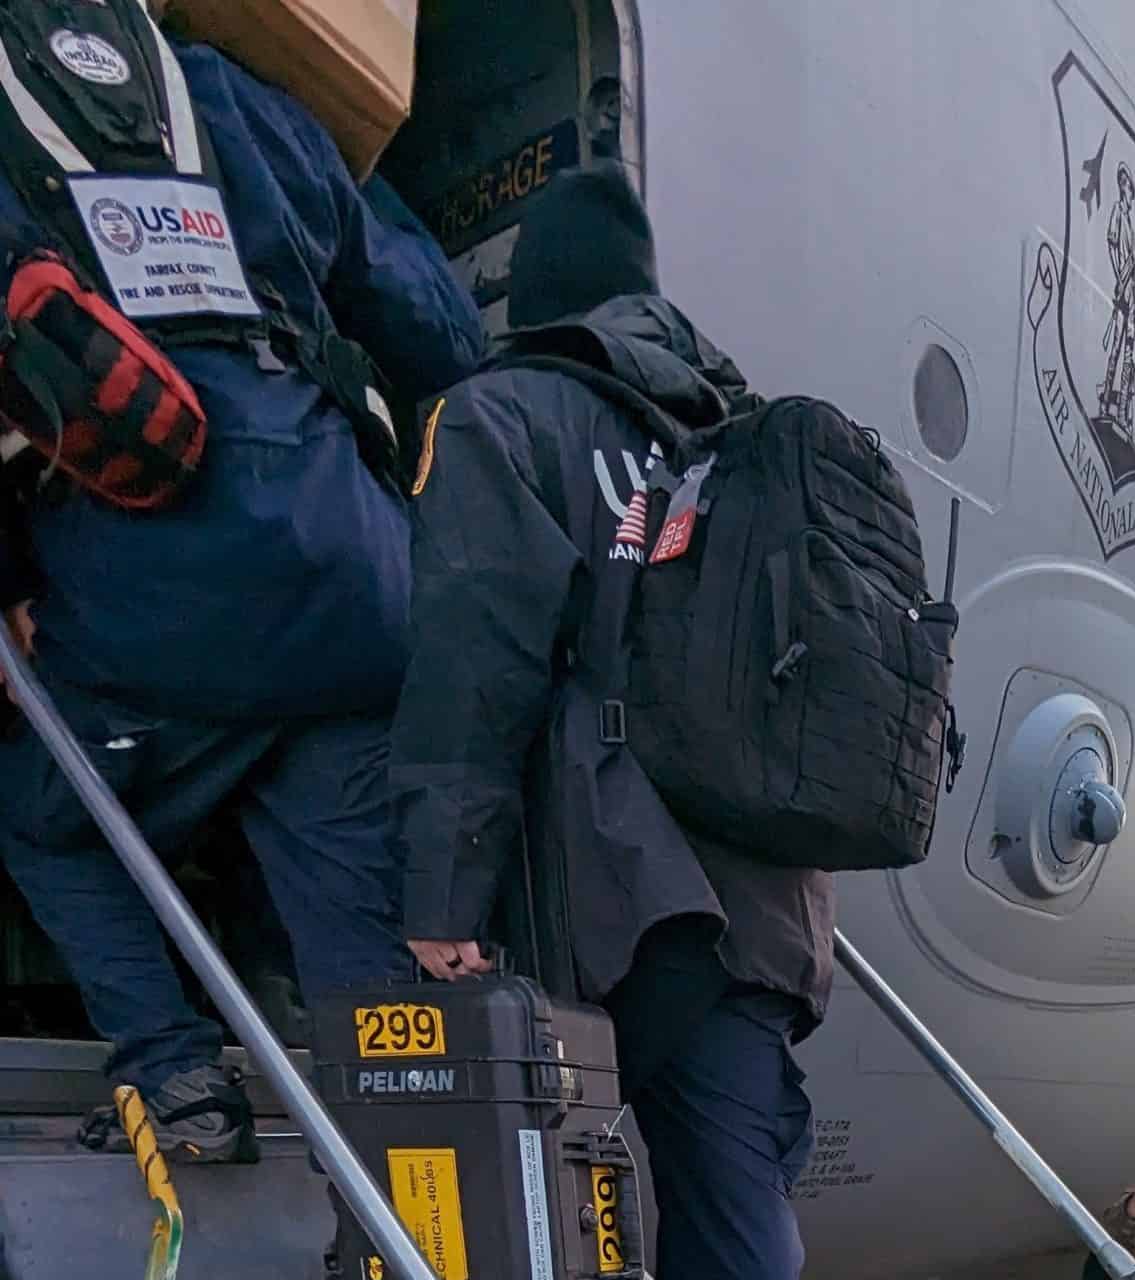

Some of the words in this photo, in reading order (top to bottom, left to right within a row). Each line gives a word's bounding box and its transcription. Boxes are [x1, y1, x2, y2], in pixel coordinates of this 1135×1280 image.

[136, 206, 225, 239] USAID
[144, 263, 182, 276] FAIRFAX
[187, 263, 216, 277] COUNTY
[119, 288, 140, 299] FIRE
[144, 286, 165, 299] AND
[168, 283, 202, 295] RESCUE
[1042, 369, 1069, 435] AIR
[1070, 432, 1135, 544] NATIONAL
[364, 1009, 436, 1050] 299
[359, 1070, 454, 1093] PELICAN
